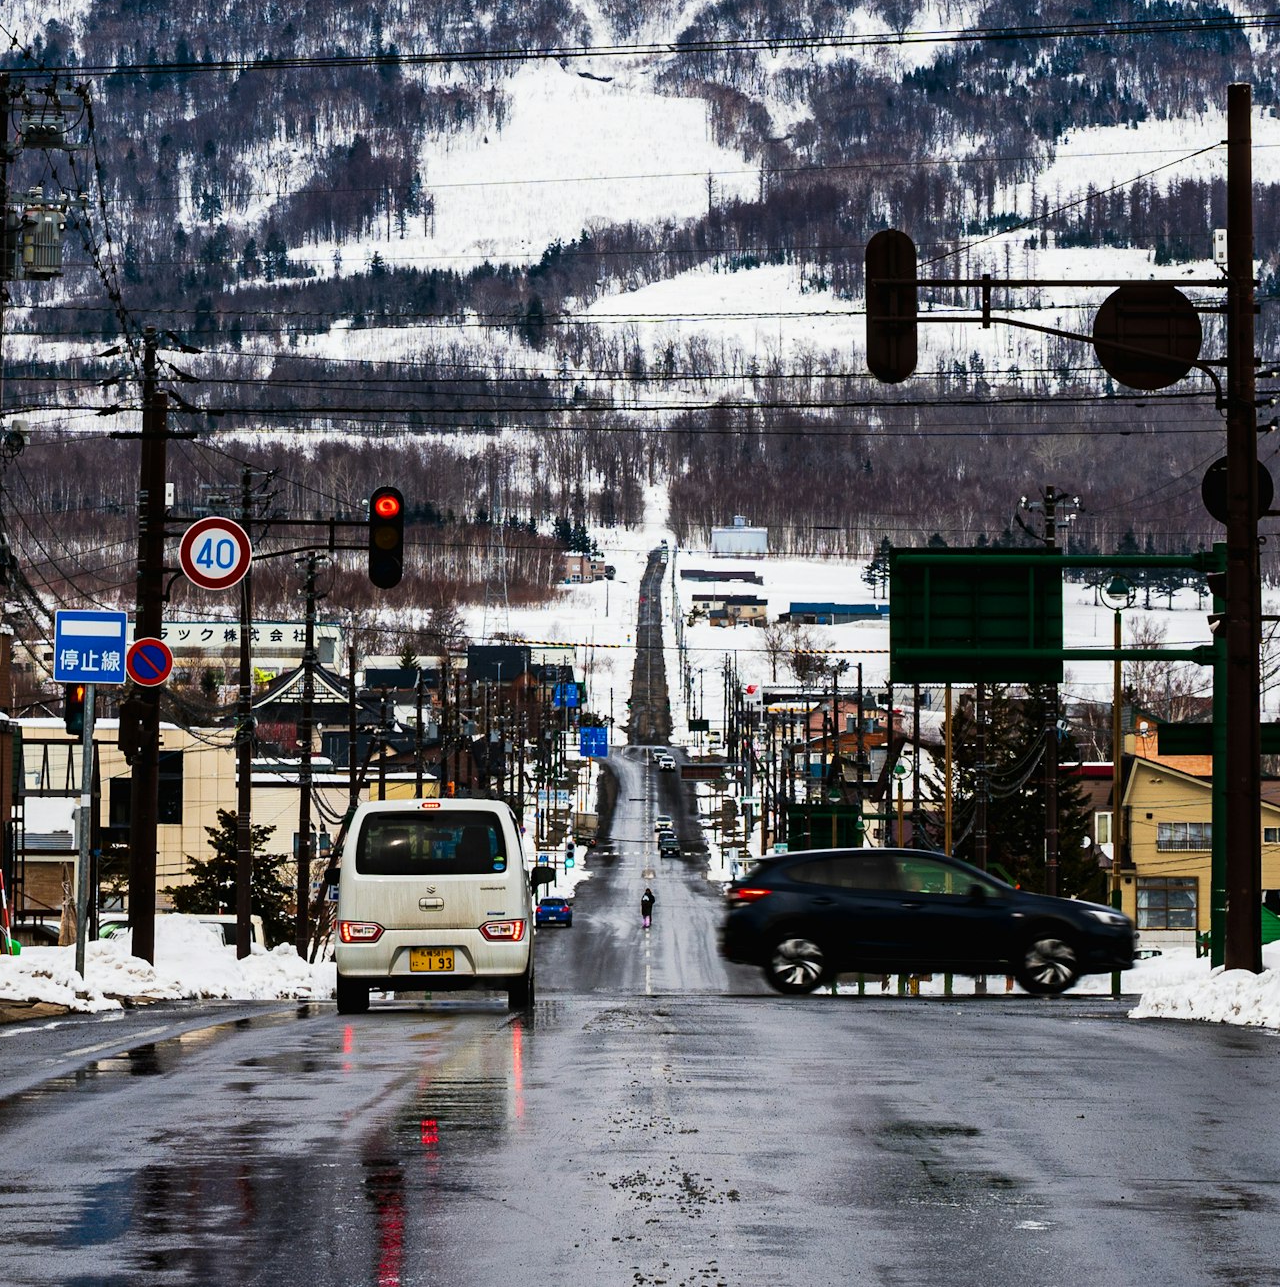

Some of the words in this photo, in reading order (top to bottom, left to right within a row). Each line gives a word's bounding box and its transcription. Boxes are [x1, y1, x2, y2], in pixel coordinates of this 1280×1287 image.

[196, 538, 234, 569] 40
[134, 628, 306, 642] ラック株式会社
[60, 649, 120, 671] 停止線
